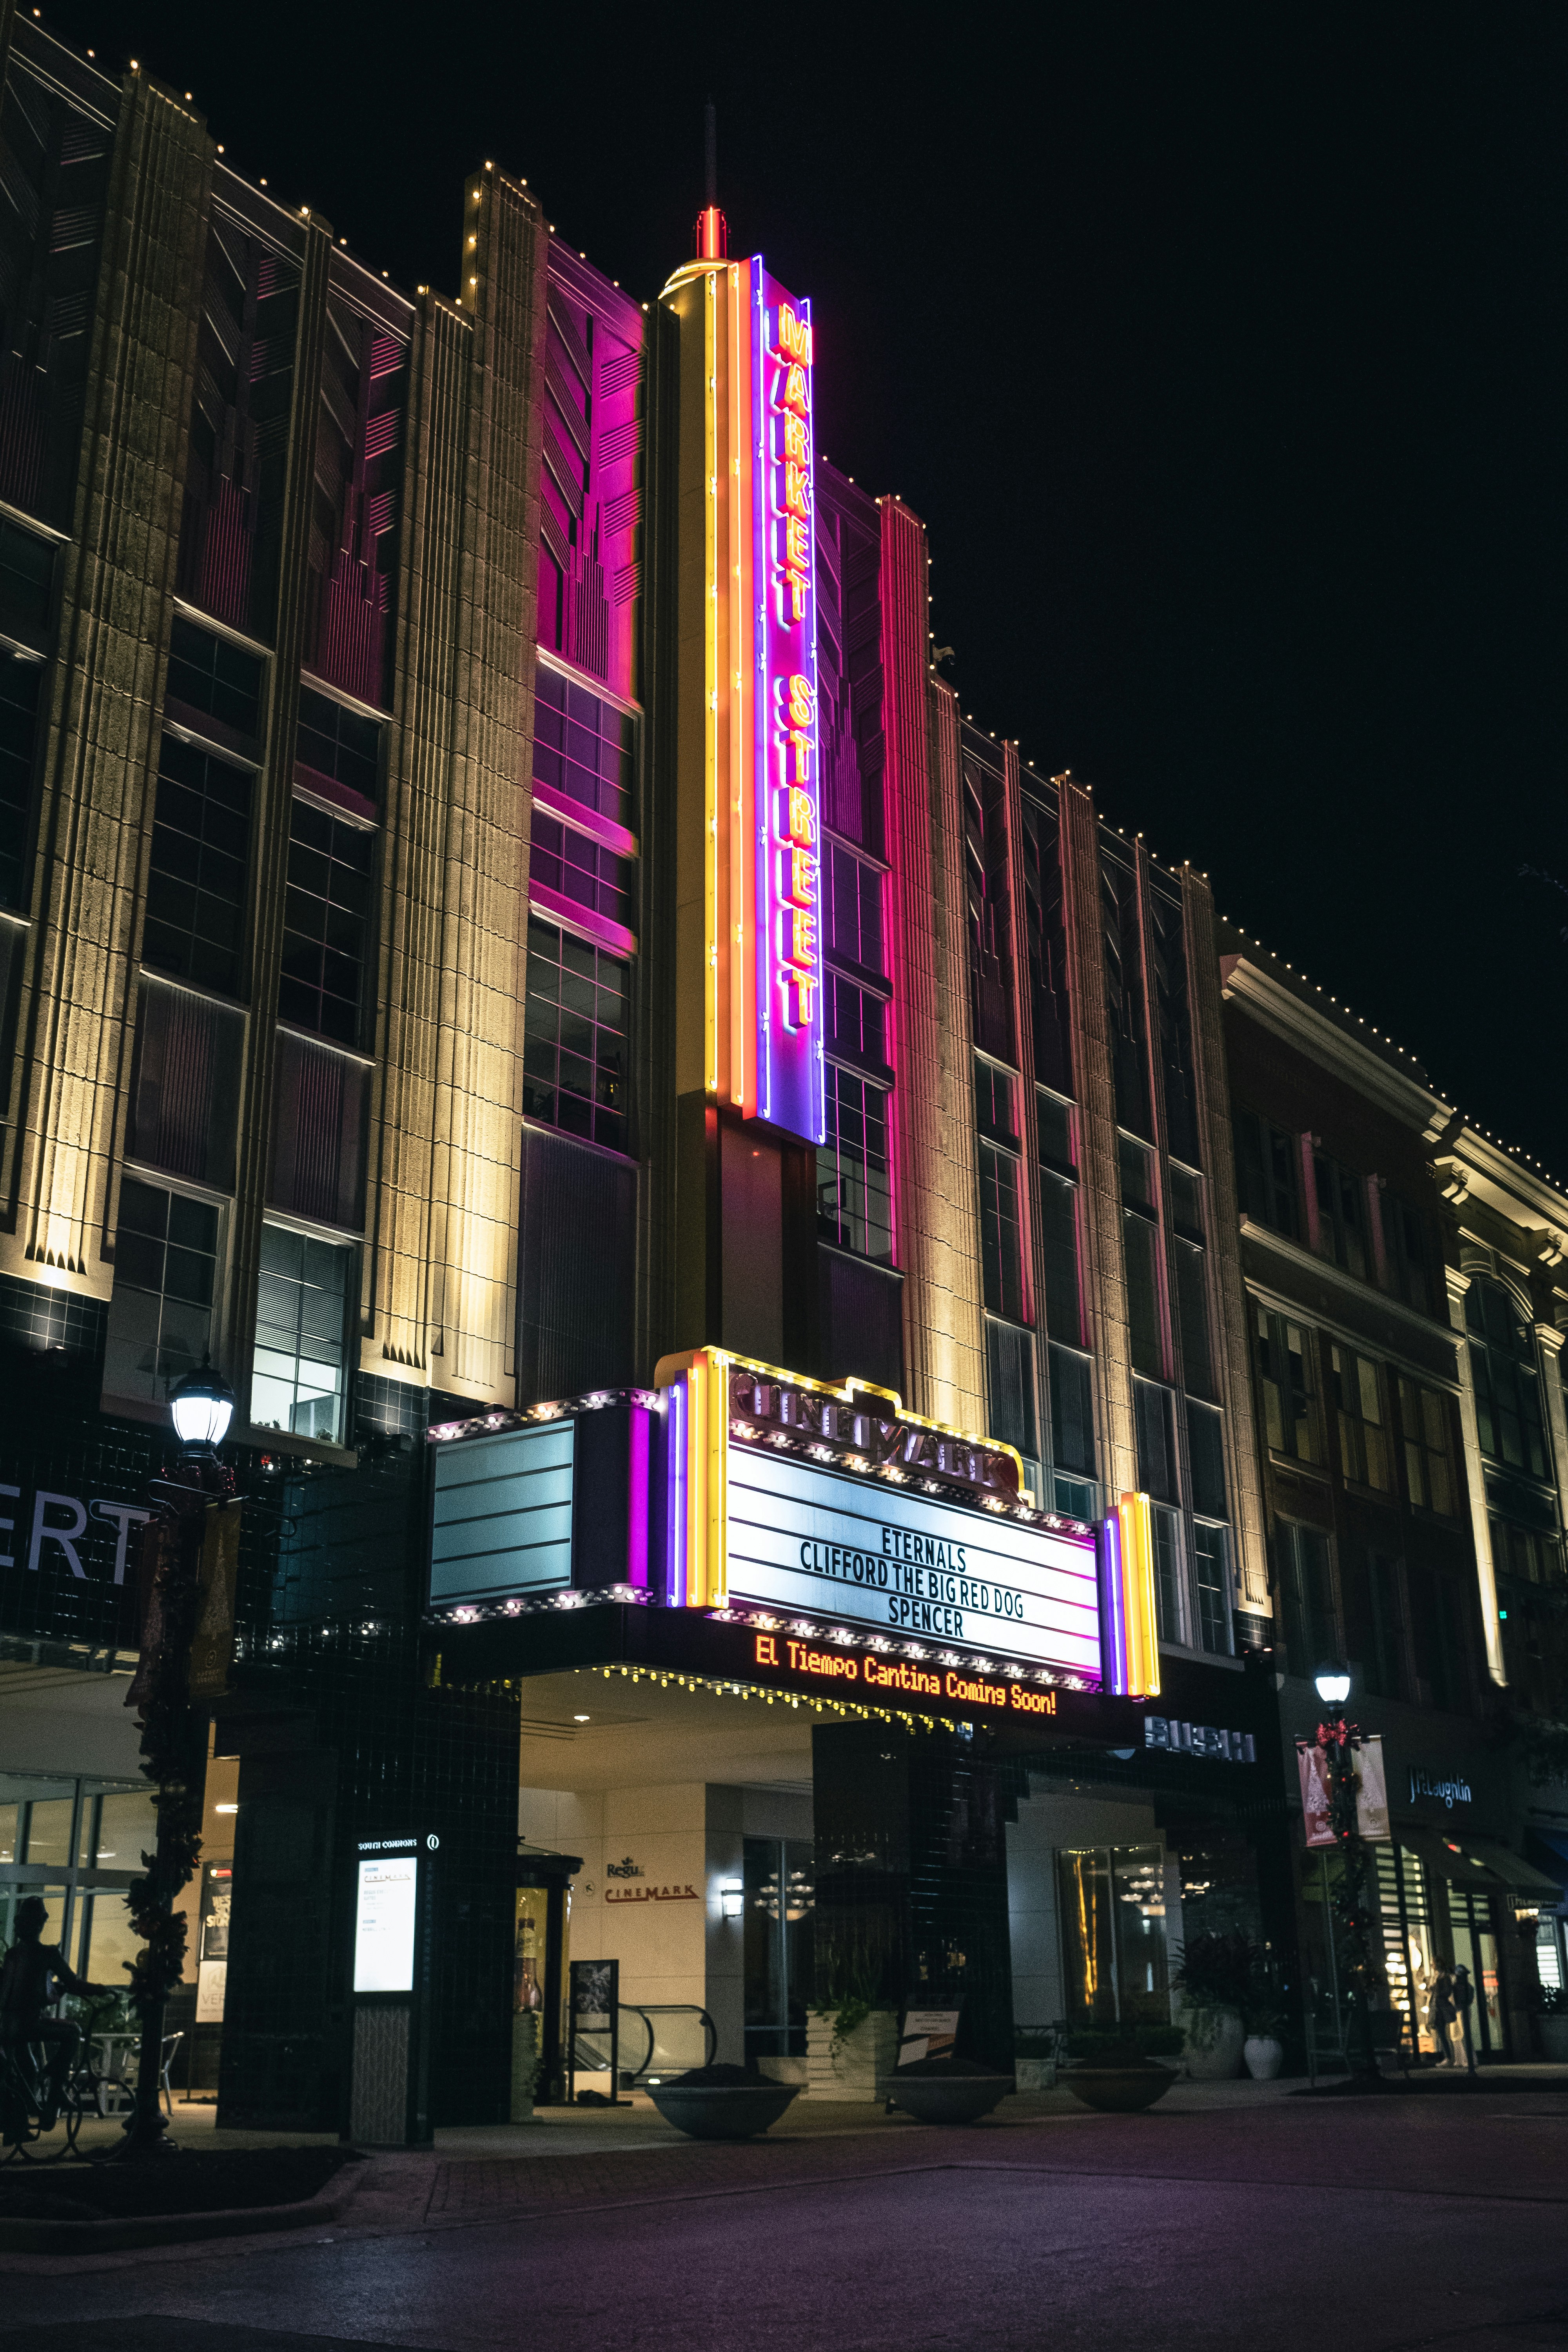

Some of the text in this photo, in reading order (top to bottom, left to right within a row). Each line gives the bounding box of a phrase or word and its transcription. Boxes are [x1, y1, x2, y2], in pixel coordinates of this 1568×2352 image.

[773, 303, 818, 1029] MARKET STREET
[882, 1527, 966, 1573] ETERNALS
[800, 1541, 1023, 1618] CLIFFORD THE BIG RED DOG
[889, 1596, 963, 1638] SPENCER
[787, 1641, 857, 1679] Tiempo
[864, 1657, 940, 1695] Cantina
[946, 1672, 1006, 1706] Coming
[1011, 1684, 1056, 1715] Soon!
[364, 1873, 412, 1883] CINEMARK
[607, 1864, 645, 1878] Regu
[605, 1885, 700, 1903] CINEMARK
